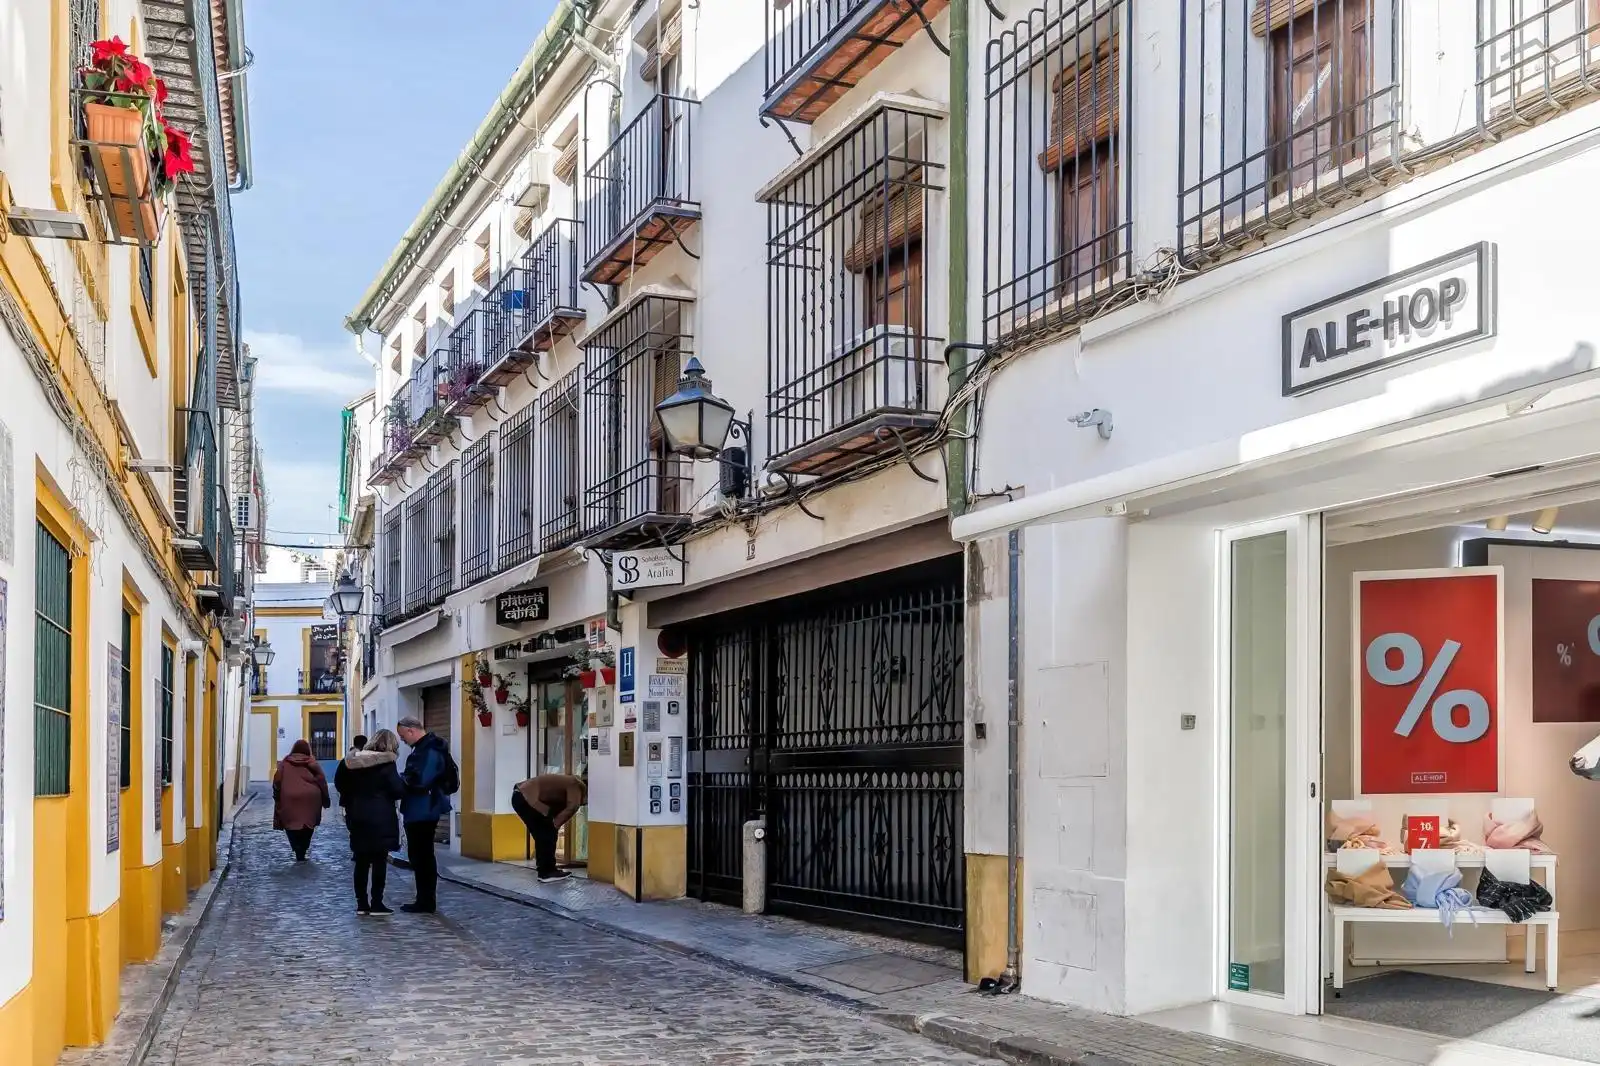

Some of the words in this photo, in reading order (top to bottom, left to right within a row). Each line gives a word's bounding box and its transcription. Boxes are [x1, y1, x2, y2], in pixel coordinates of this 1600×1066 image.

[1299, 276, 1463, 368] ALE-HOP
[747, 543, 756, 556] 19
[647, 567, 674, 578] Aralia
[623, 651, 632, 677] H
[1365, 632, 1490, 743] %
[1413, 774, 1445, 782] ALE-HOP
